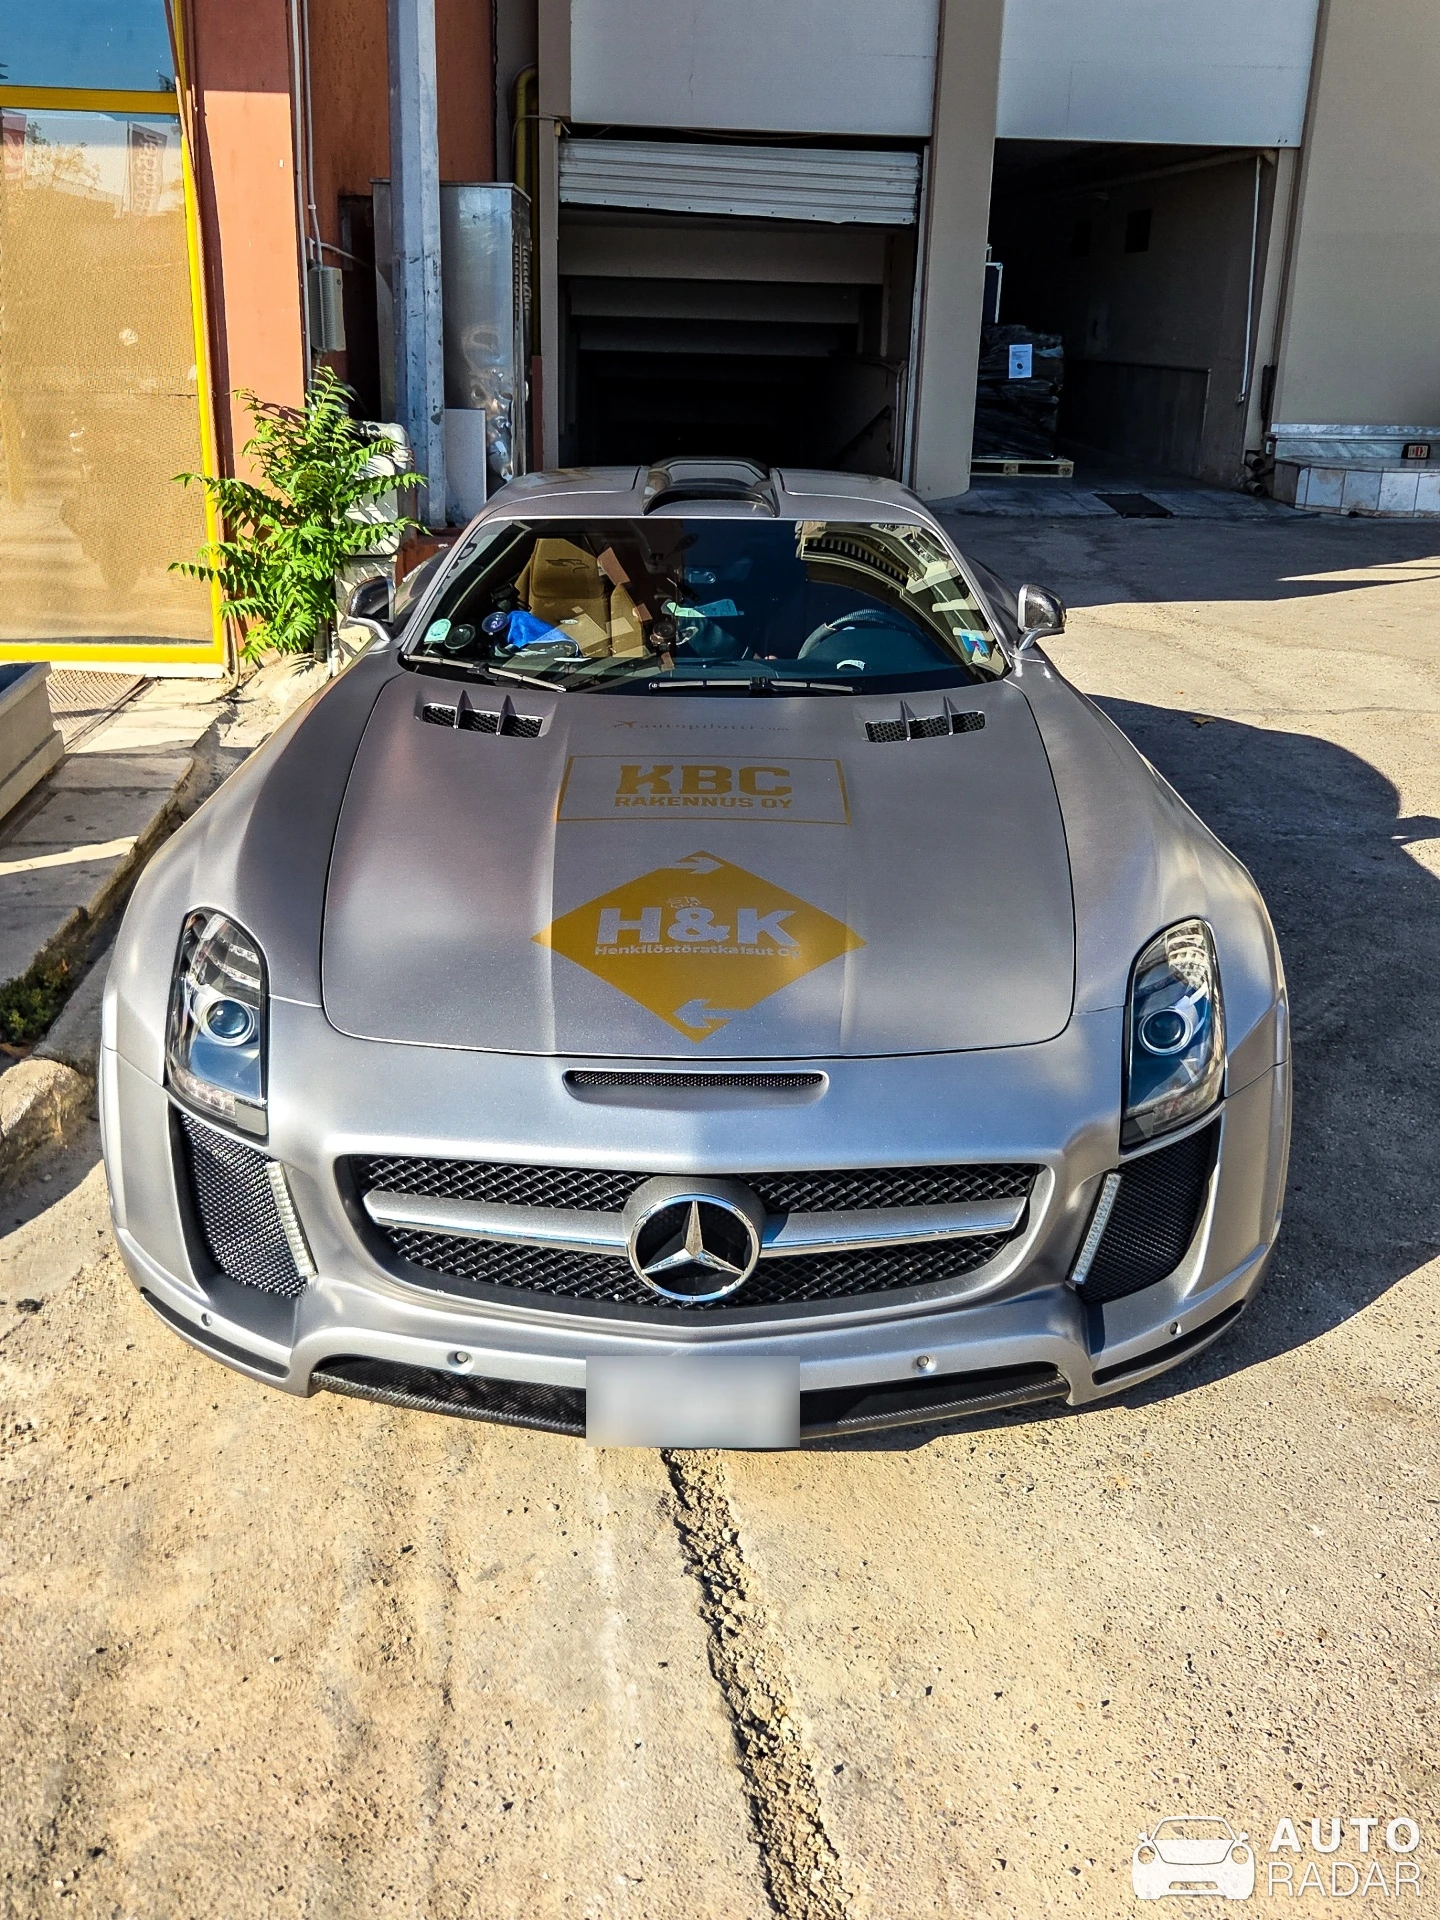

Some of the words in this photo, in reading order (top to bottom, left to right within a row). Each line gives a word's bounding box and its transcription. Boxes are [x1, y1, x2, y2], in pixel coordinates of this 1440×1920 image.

[615, 764, 793, 796] KBC
[613, 796, 754, 808] RAKENNUS
[761, 798, 793, 809] OY
[596, 907, 800, 947] H&K
[594, 943, 774, 956] Henkilöstöratkaisut
